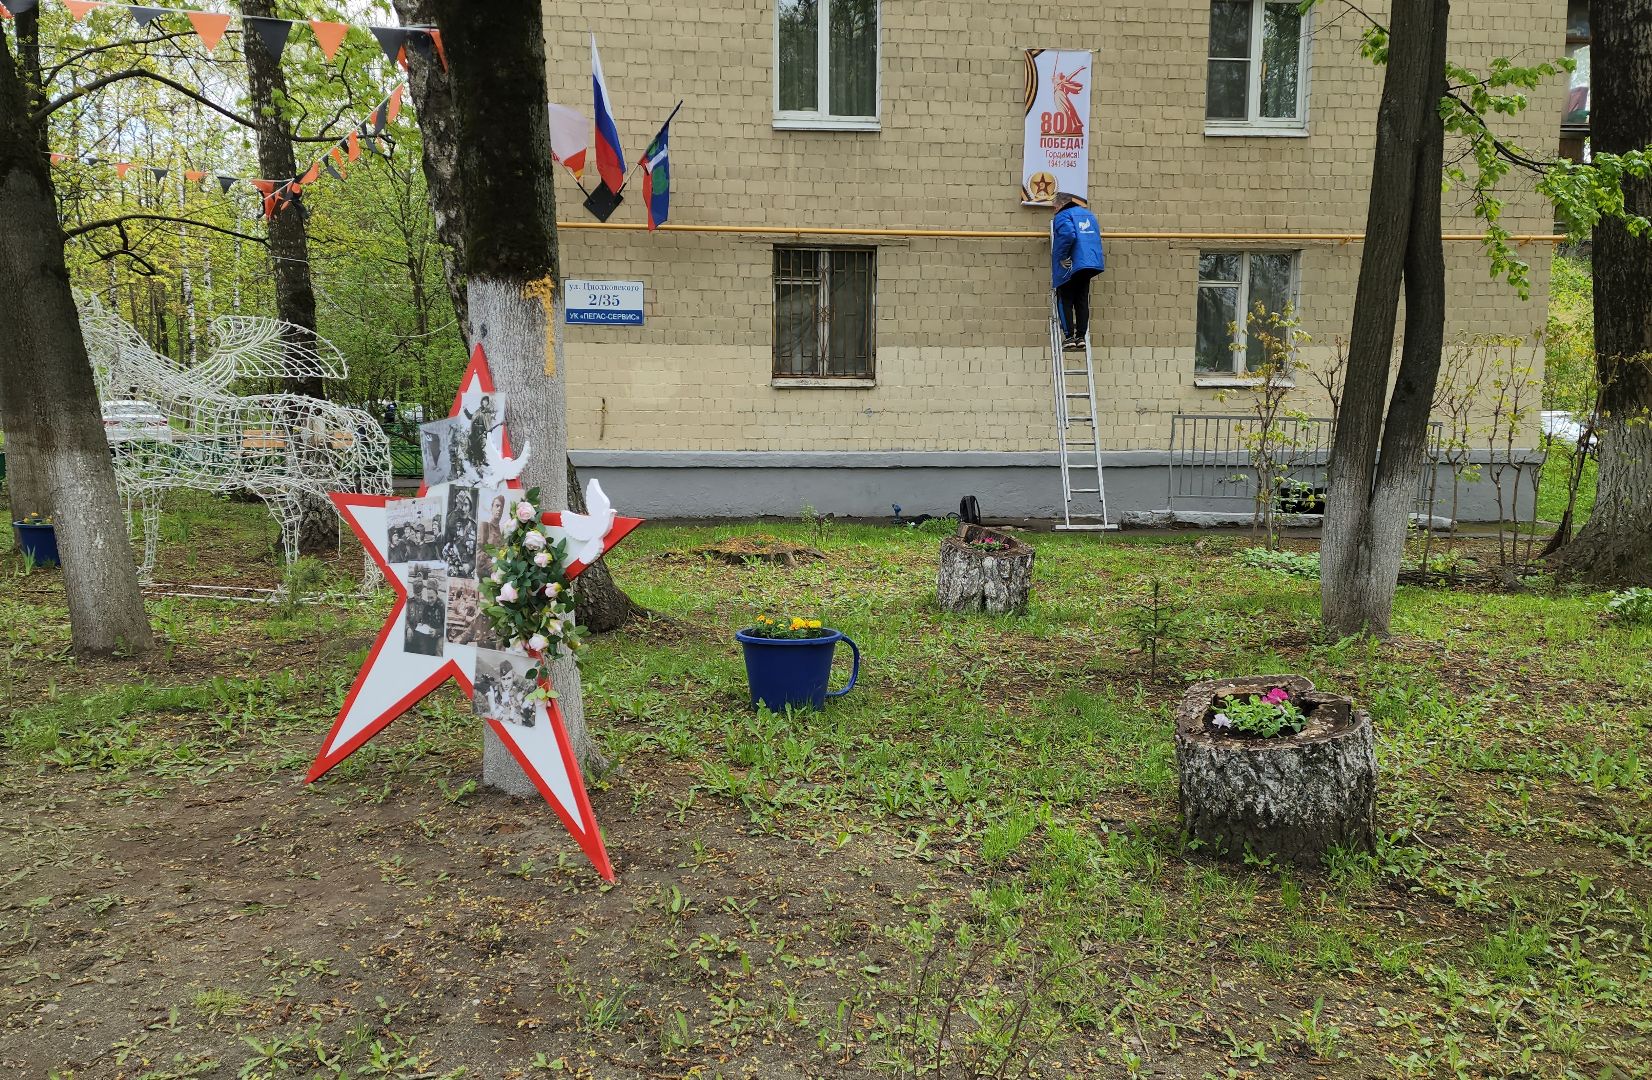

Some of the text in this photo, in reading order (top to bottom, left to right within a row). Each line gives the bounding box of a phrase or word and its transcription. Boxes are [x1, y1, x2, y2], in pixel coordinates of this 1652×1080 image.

[1041, 112, 1064, 134] 80
[1040, 137, 1084, 150] ПОБЕДА!
[1045, 150, 1080, 159] Гордимся!
[1048, 160, 1077, 168] 1941-1945
[569, 282, 640, 292] ул. Циолковского
[588, 294, 620, 307] 2/35
[569, 312, 640, 321] УК «ПЕГАС-СЕРВИС»
